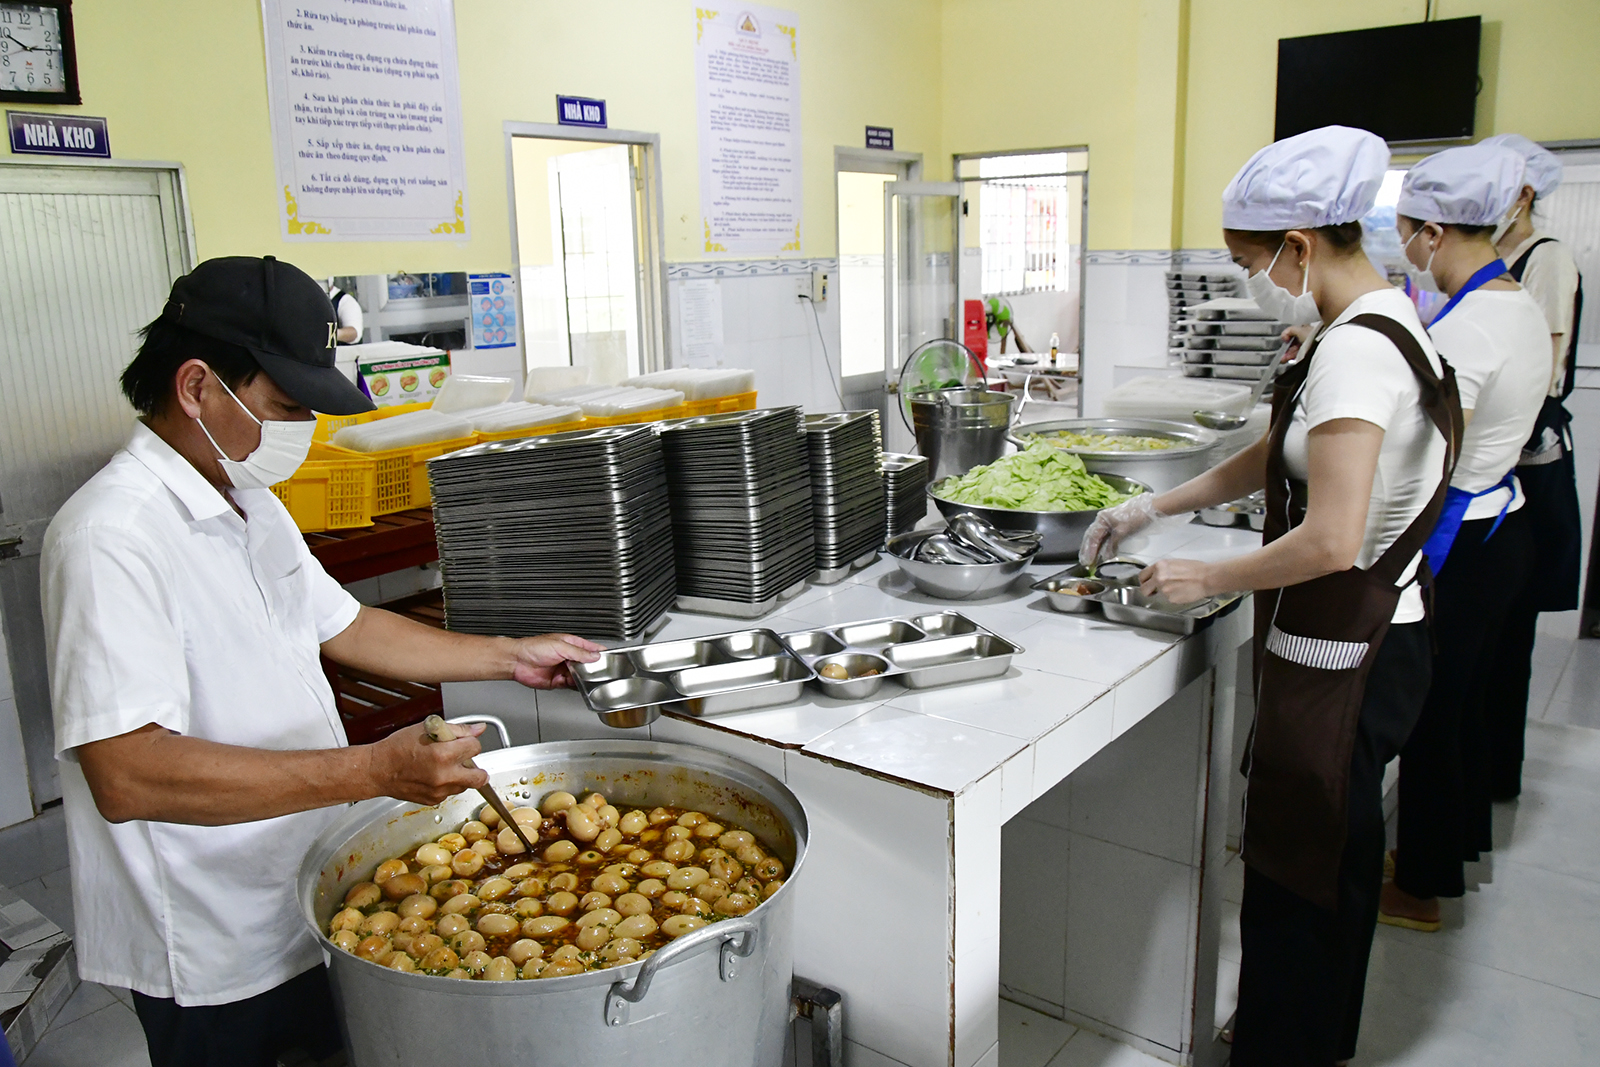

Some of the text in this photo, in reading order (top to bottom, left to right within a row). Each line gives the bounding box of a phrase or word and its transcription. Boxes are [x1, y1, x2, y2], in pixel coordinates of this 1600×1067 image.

[2, 12, 44, 26] 11 12 1
[296, 9, 302, 18] 2.
[44, 31, 51, 42] 2
[1, 41, 8, 52] 9
[46, 44, 52, 56] 3
[300, 45, 306, 53] 3.
[3, 55, 10, 67] 8
[47, 59, 52, 69] 4
[10, 71, 50, 84] 7 6 5
[564, 101, 600, 122] NHÀ KHO
[23, 120, 96, 149] NHÀ KHO
[308, 138, 314, 147] 5.
[326, 322, 337, 349] K
